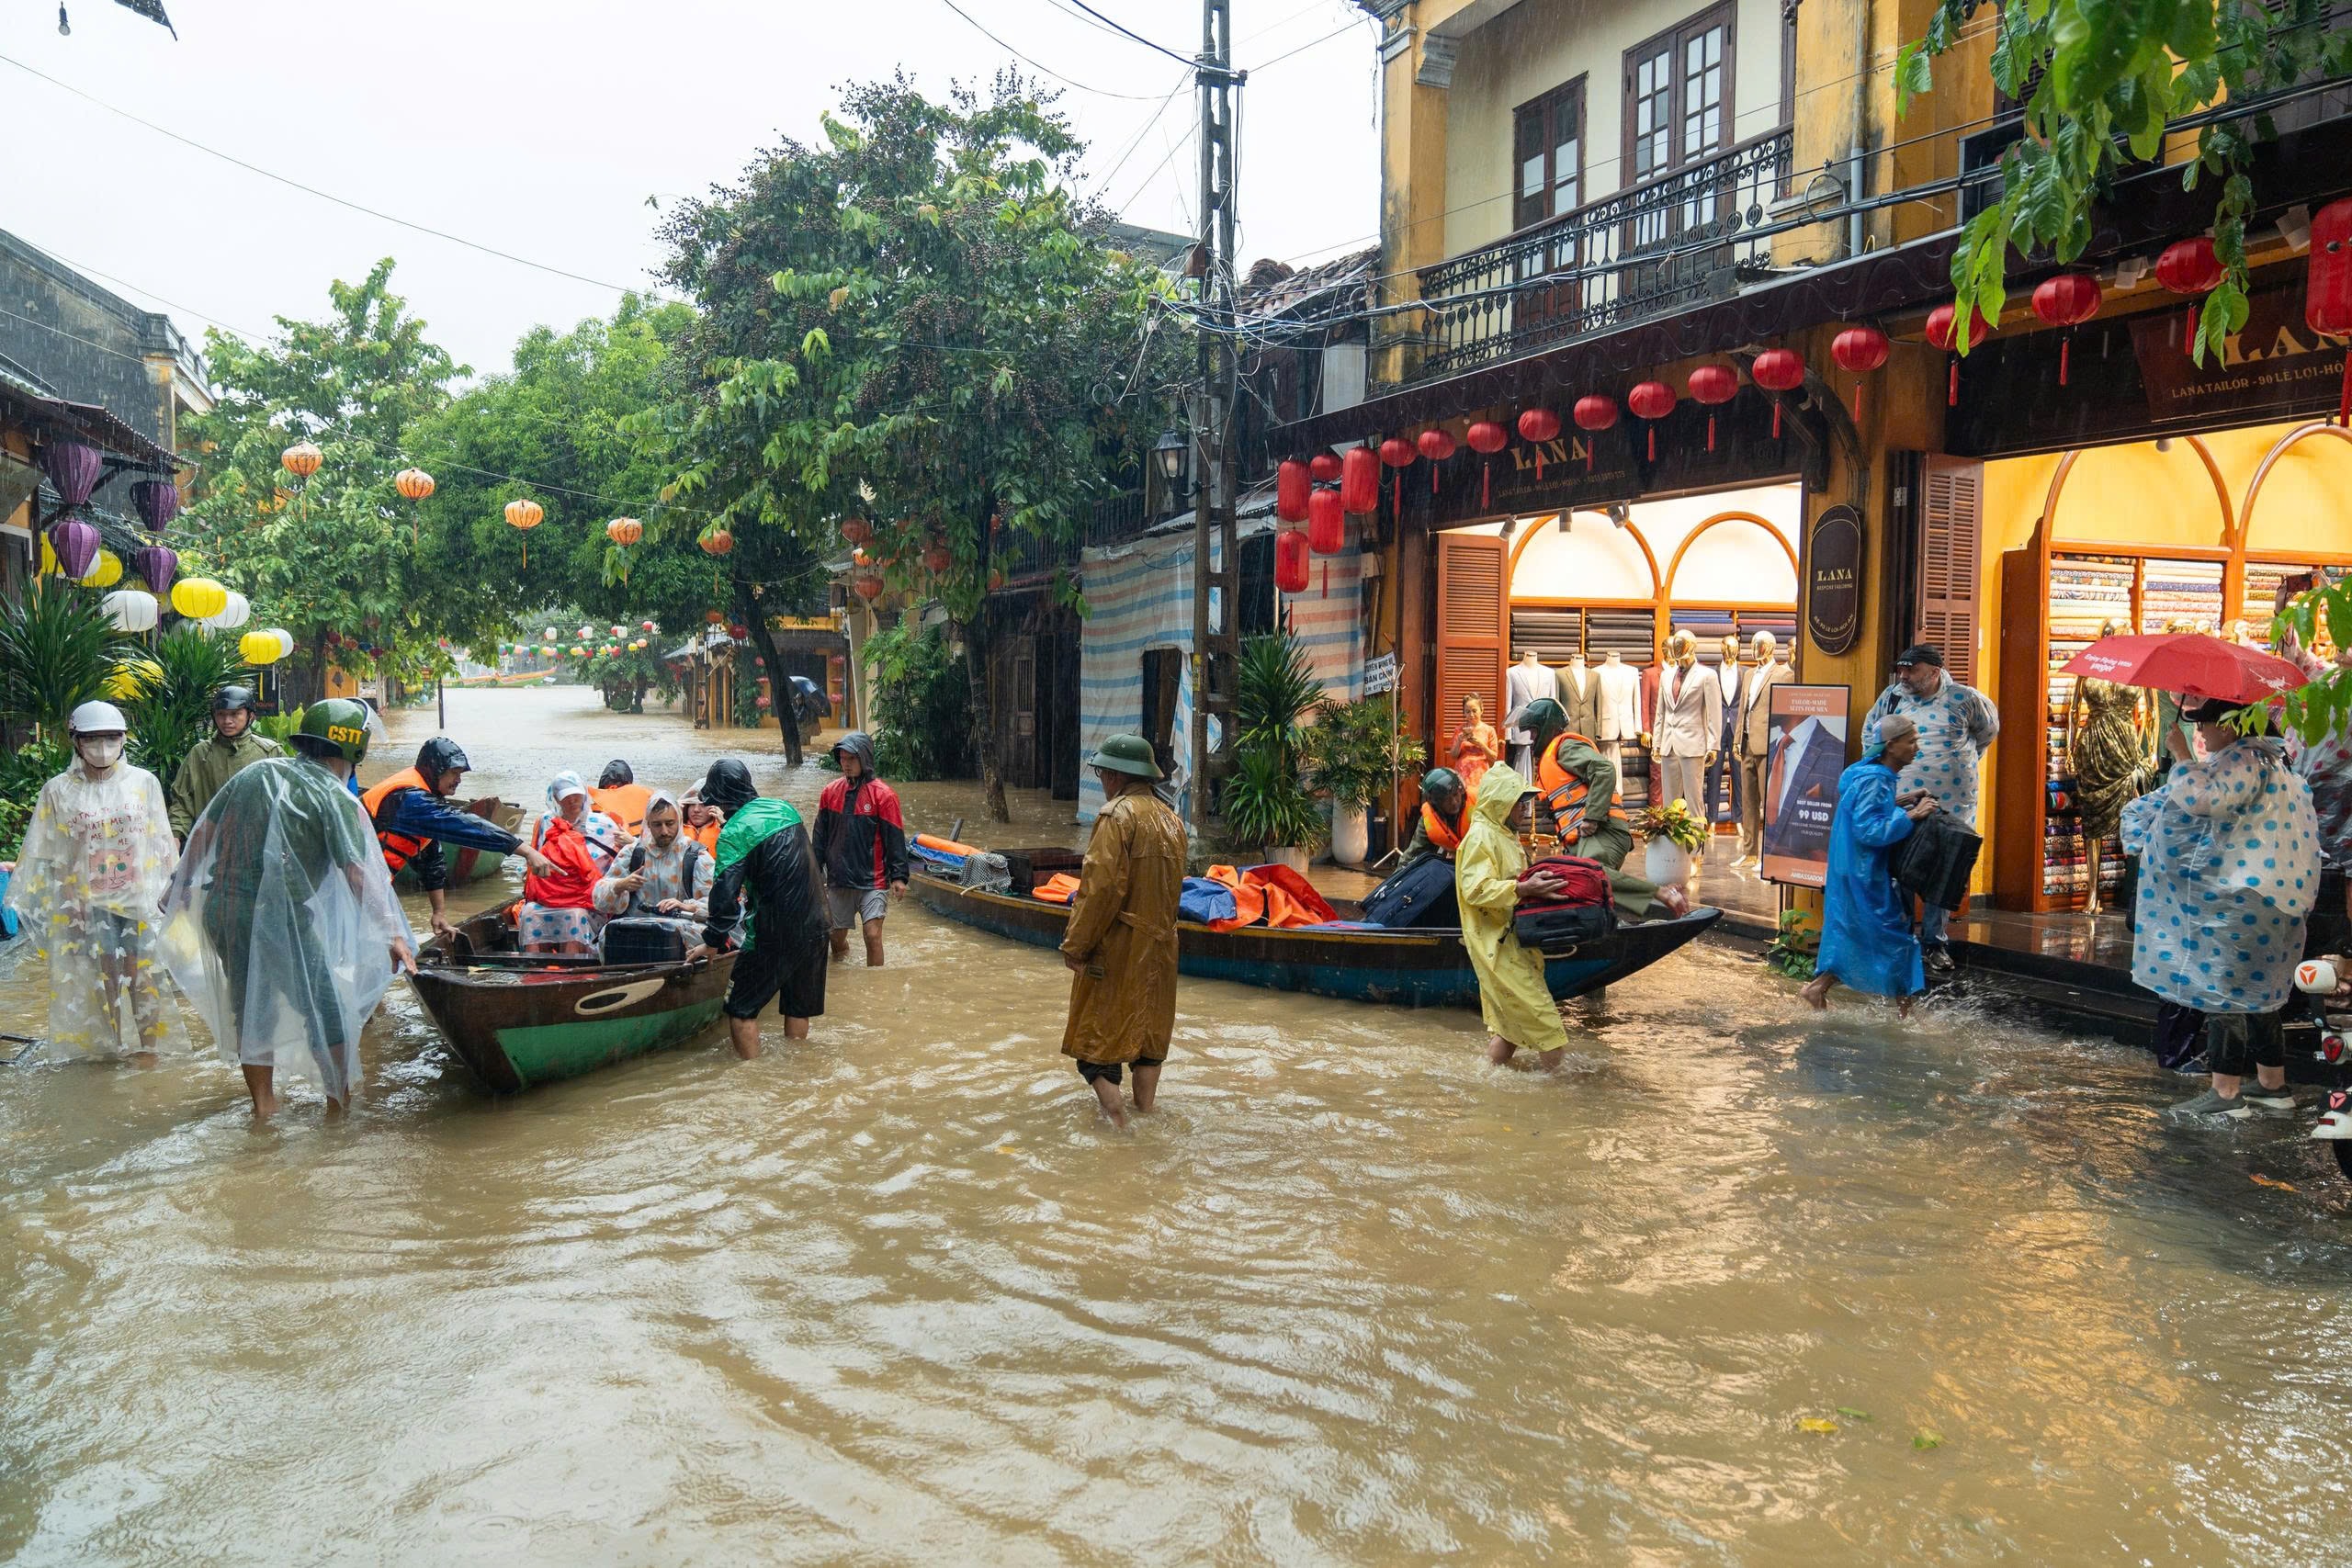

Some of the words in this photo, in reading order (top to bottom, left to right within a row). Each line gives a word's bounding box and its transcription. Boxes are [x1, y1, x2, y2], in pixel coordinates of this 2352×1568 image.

[2223, 325, 2352, 367] LA
[2171, 385, 2204, 399] LANA
[2204, 378, 2249, 394] TAILOR
[1510, 435, 1589, 471] LANA
[1817, 568, 1853, 581] LANA
[327, 725, 363, 745] CSTT
[110, 817, 125, 826] ME
[1798, 809, 1810, 820] 99
[1812, 810, 1829, 822] USD
[118, 837, 130, 846] ME
